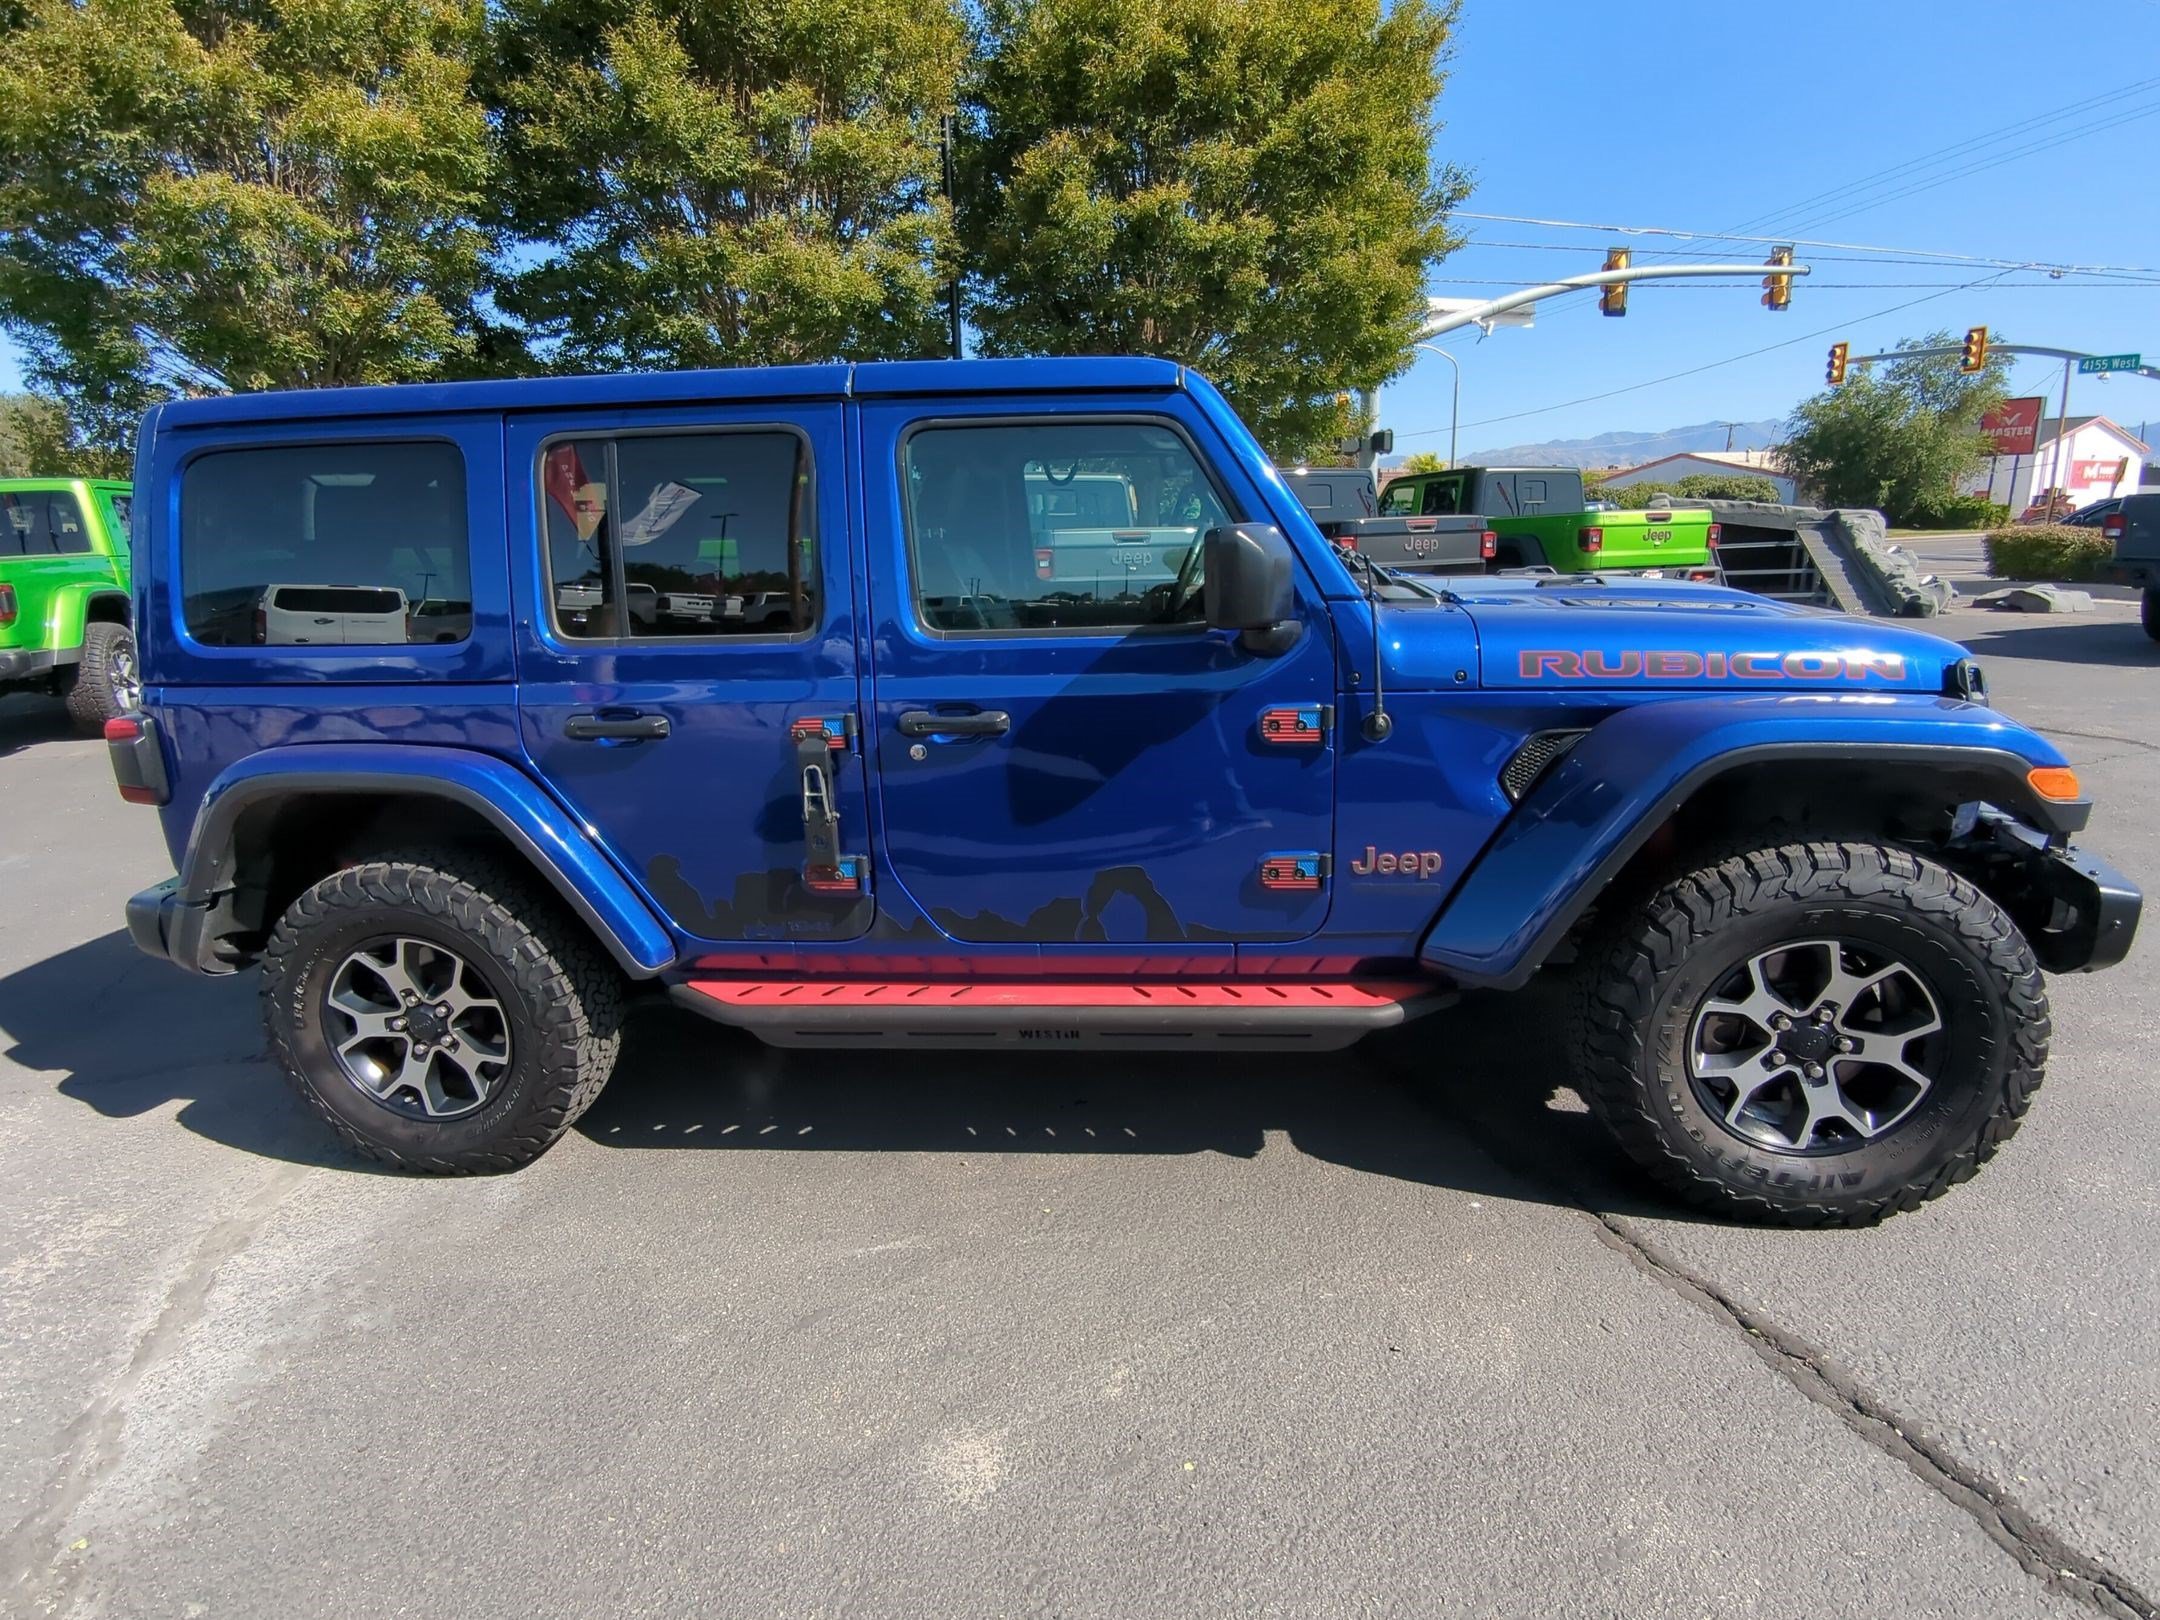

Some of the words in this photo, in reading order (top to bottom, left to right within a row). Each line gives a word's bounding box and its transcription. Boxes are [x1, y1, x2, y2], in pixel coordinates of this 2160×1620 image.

[2082, 359, 2108, 371] 4155
[2112, 358, 2136, 369] West
[1642, 529, 1672, 542] Jeep
[1404, 536, 1439, 552] Jeep
[1111, 549, 1153, 566] Jeep
[1519, 649, 1907, 680] RUBICON
[1351, 846, 1442, 880] Jeep
